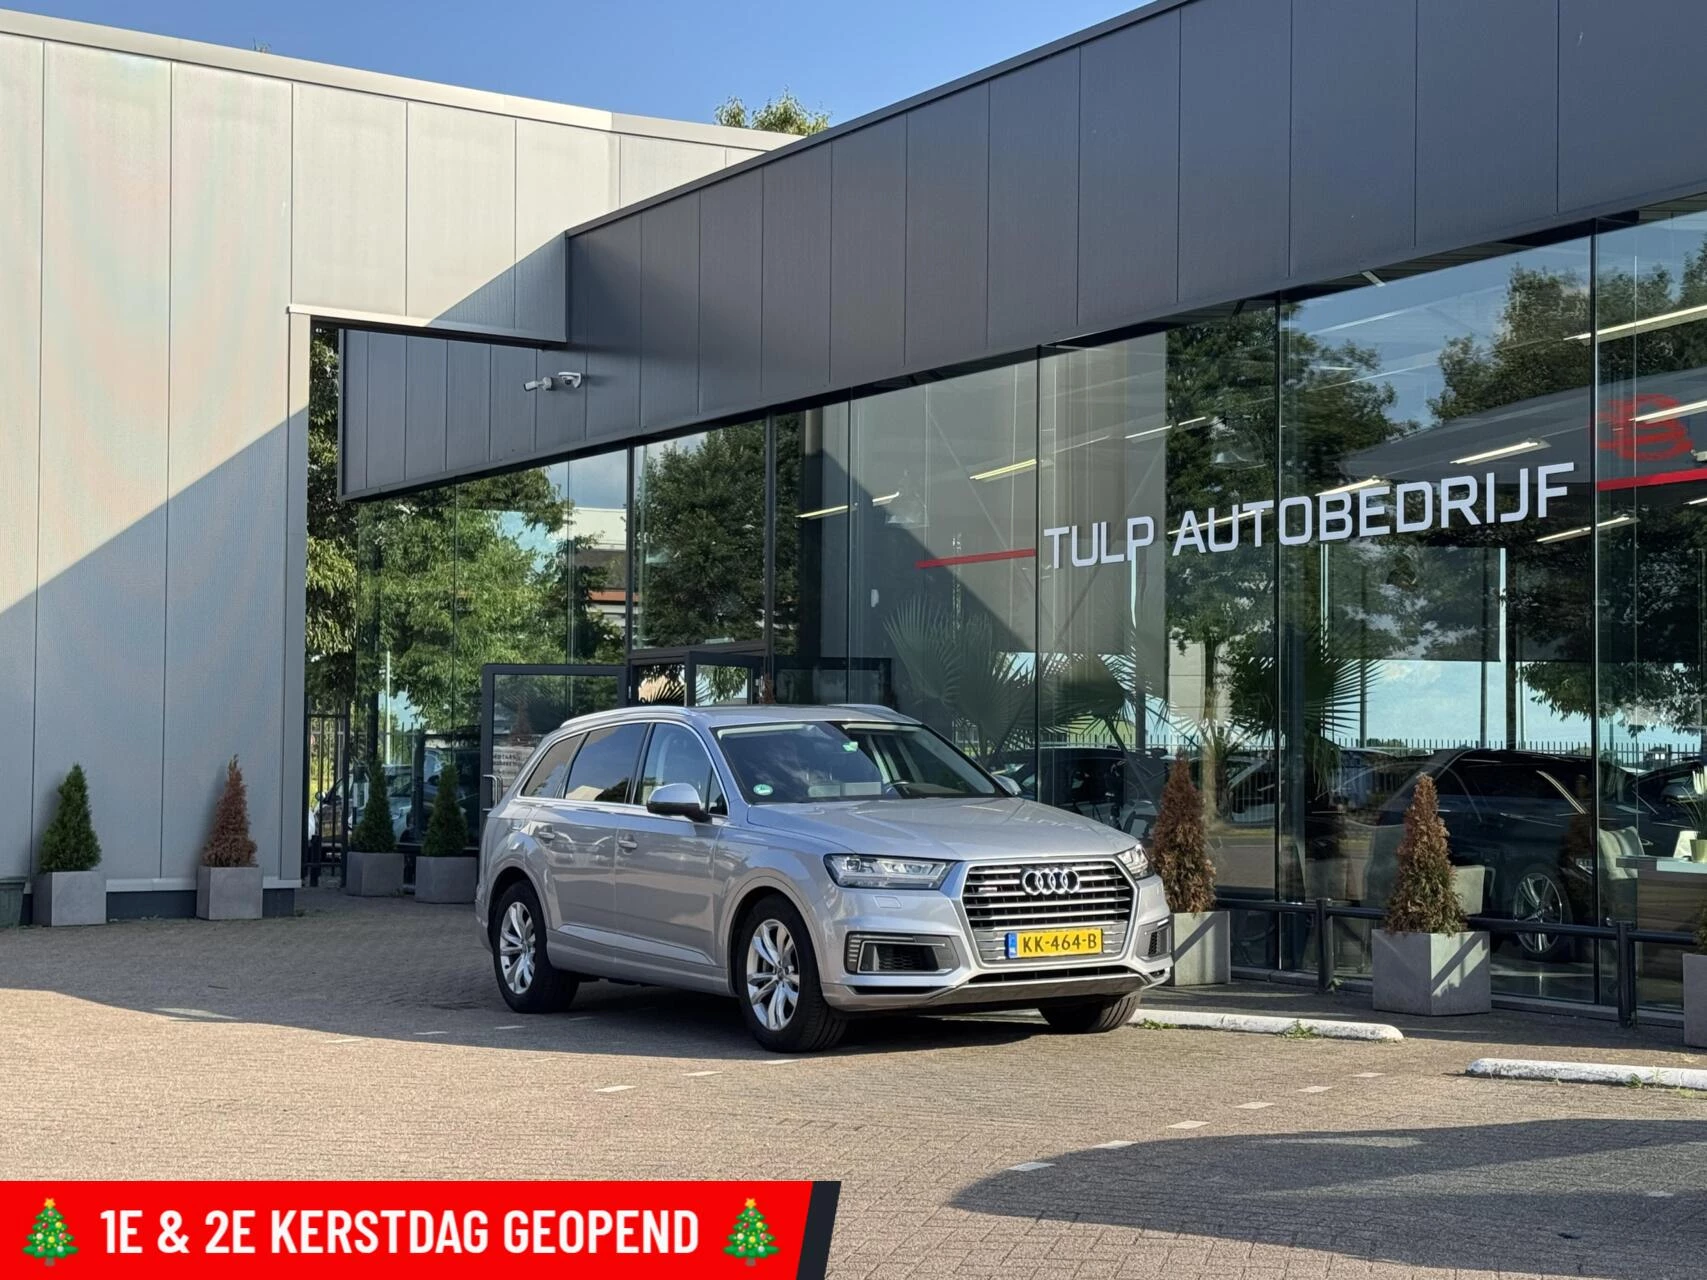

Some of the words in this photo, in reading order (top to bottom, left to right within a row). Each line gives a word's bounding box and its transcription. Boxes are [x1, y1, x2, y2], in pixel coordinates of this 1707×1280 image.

[1043, 515, 1155, 570] TULP
[1171, 462, 1575, 557] AUTOBEDRIJF
[1022, 932, 1097, 953] KK-464-B
